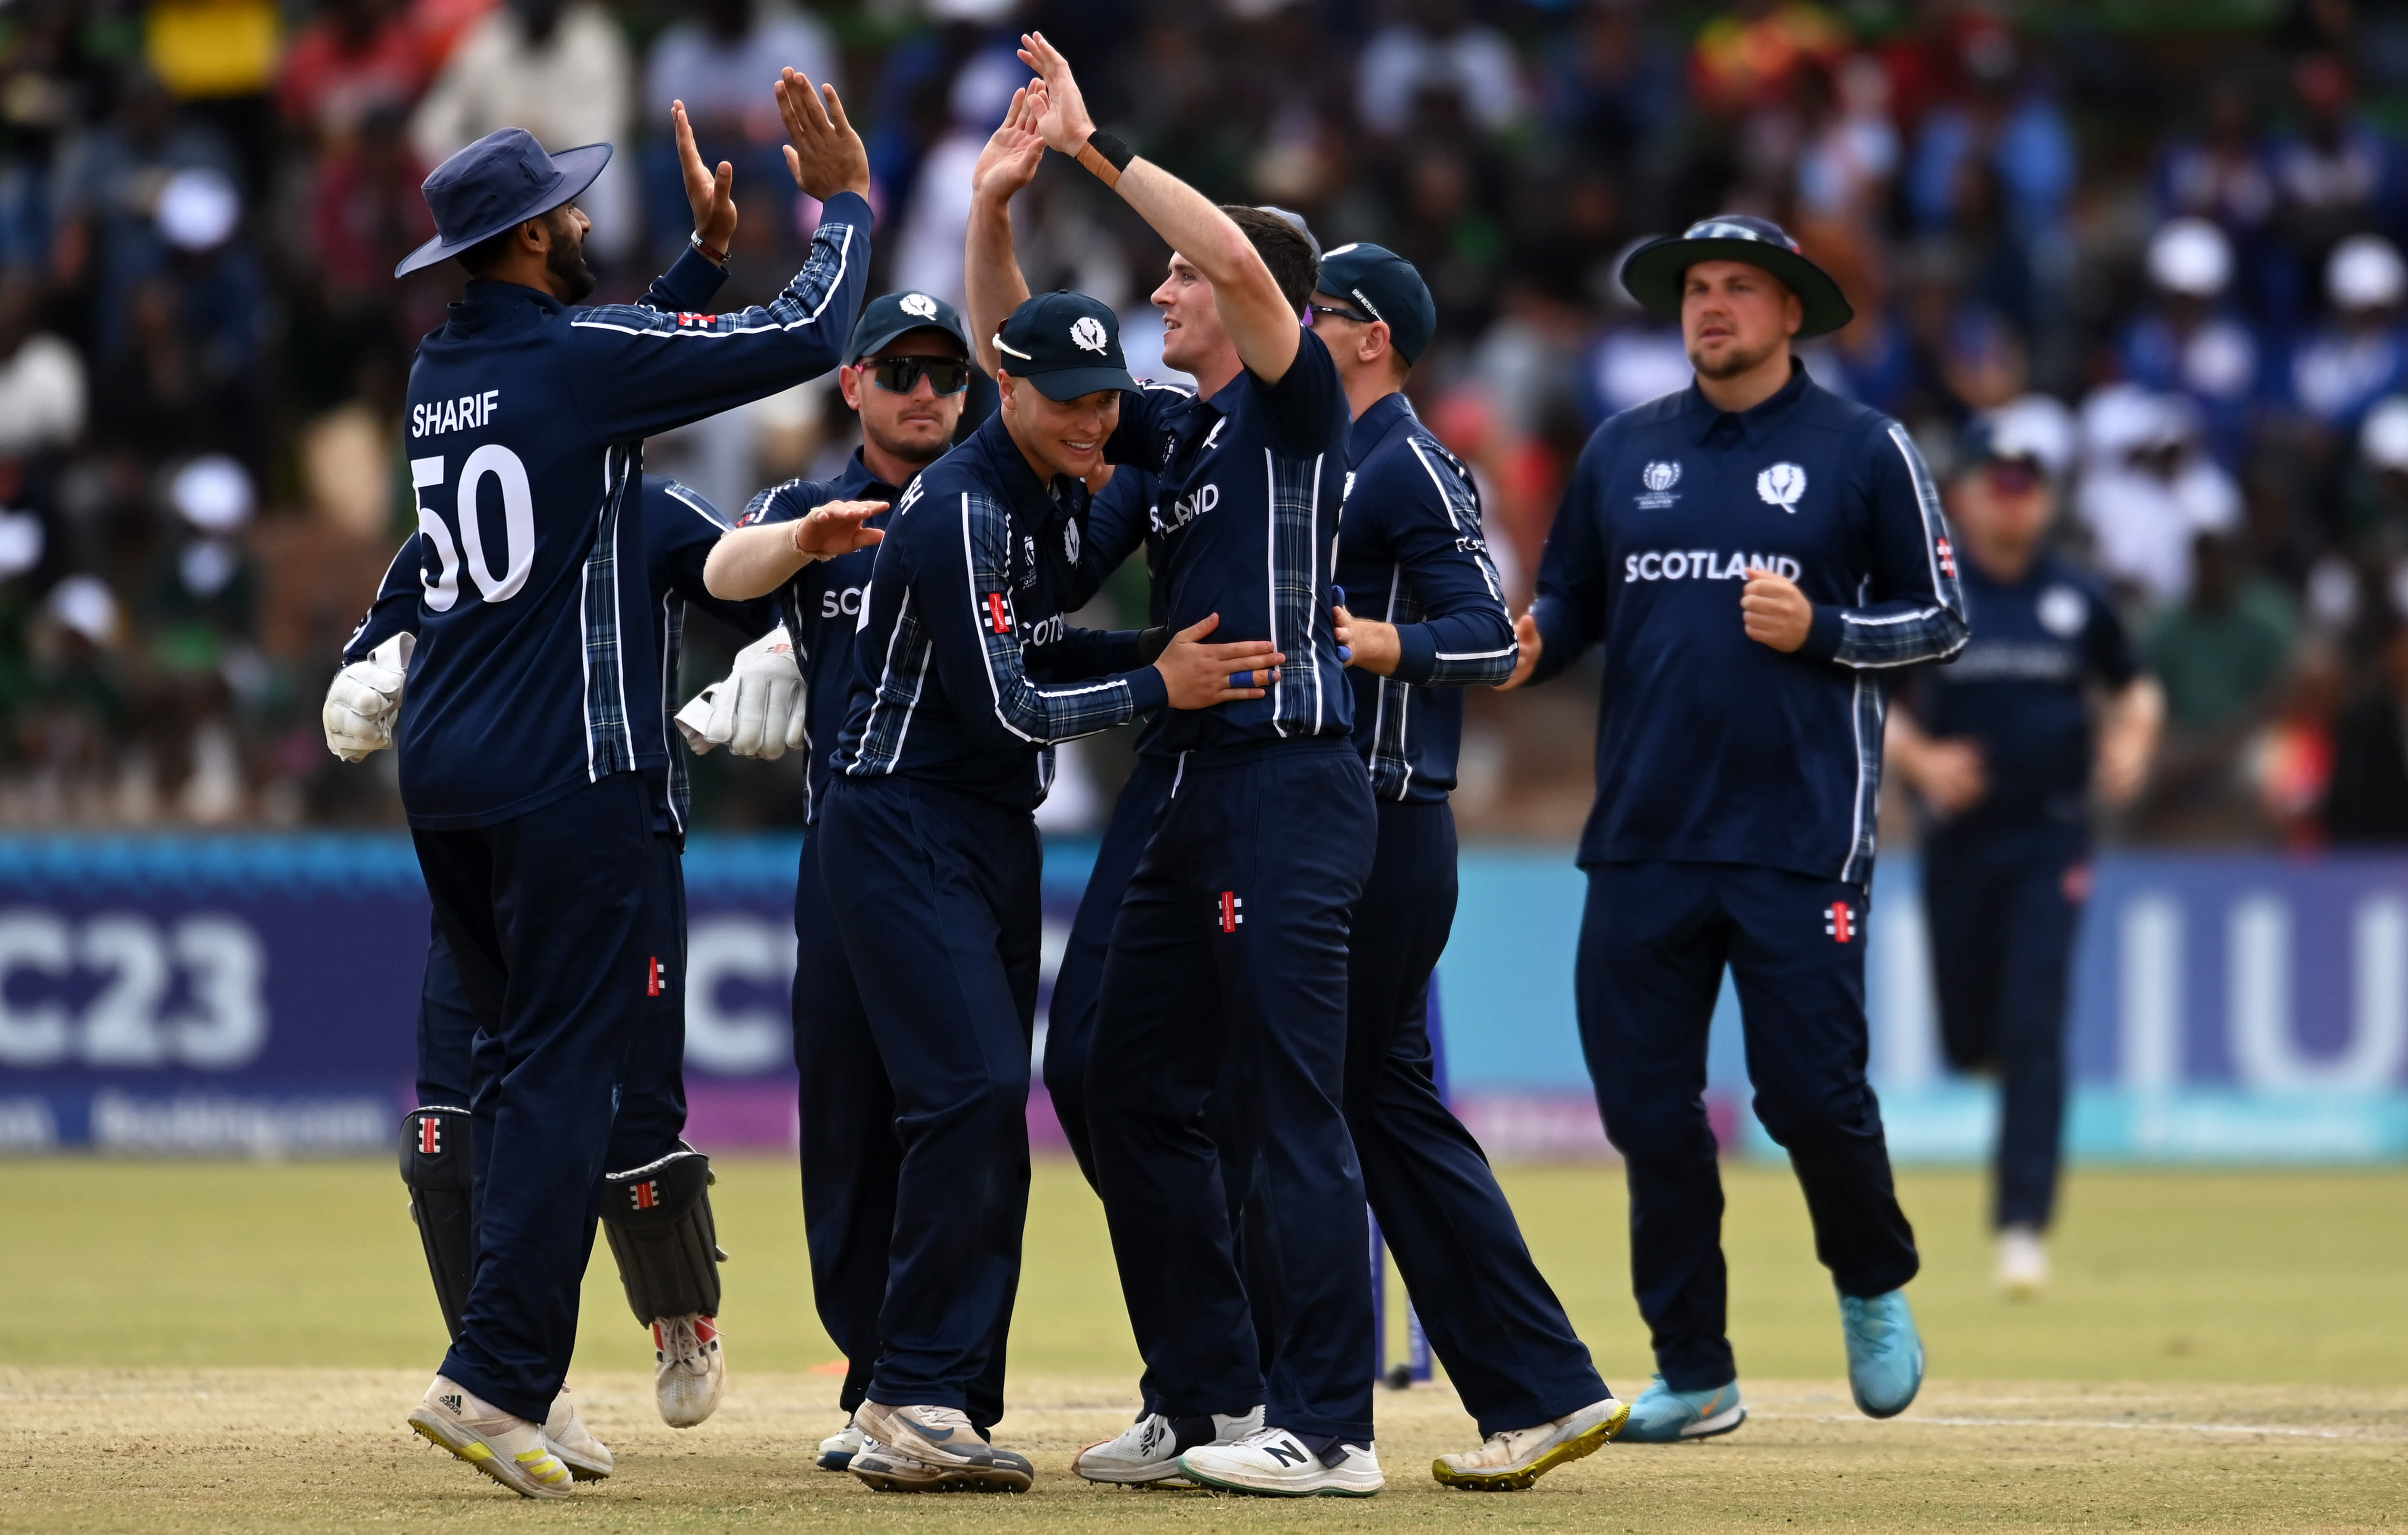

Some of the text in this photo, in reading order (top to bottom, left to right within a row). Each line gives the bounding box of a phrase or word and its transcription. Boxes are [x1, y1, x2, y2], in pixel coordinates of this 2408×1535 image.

[412, 389, 498, 438] SHARIF
[411, 444, 535, 612] 50
[1624, 551, 1801, 583] SCOTLAND
[822, 586, 869, 618] SC
[0, 913, 265, 1065] C23
[439, 1396, 462, 1416] adidas
